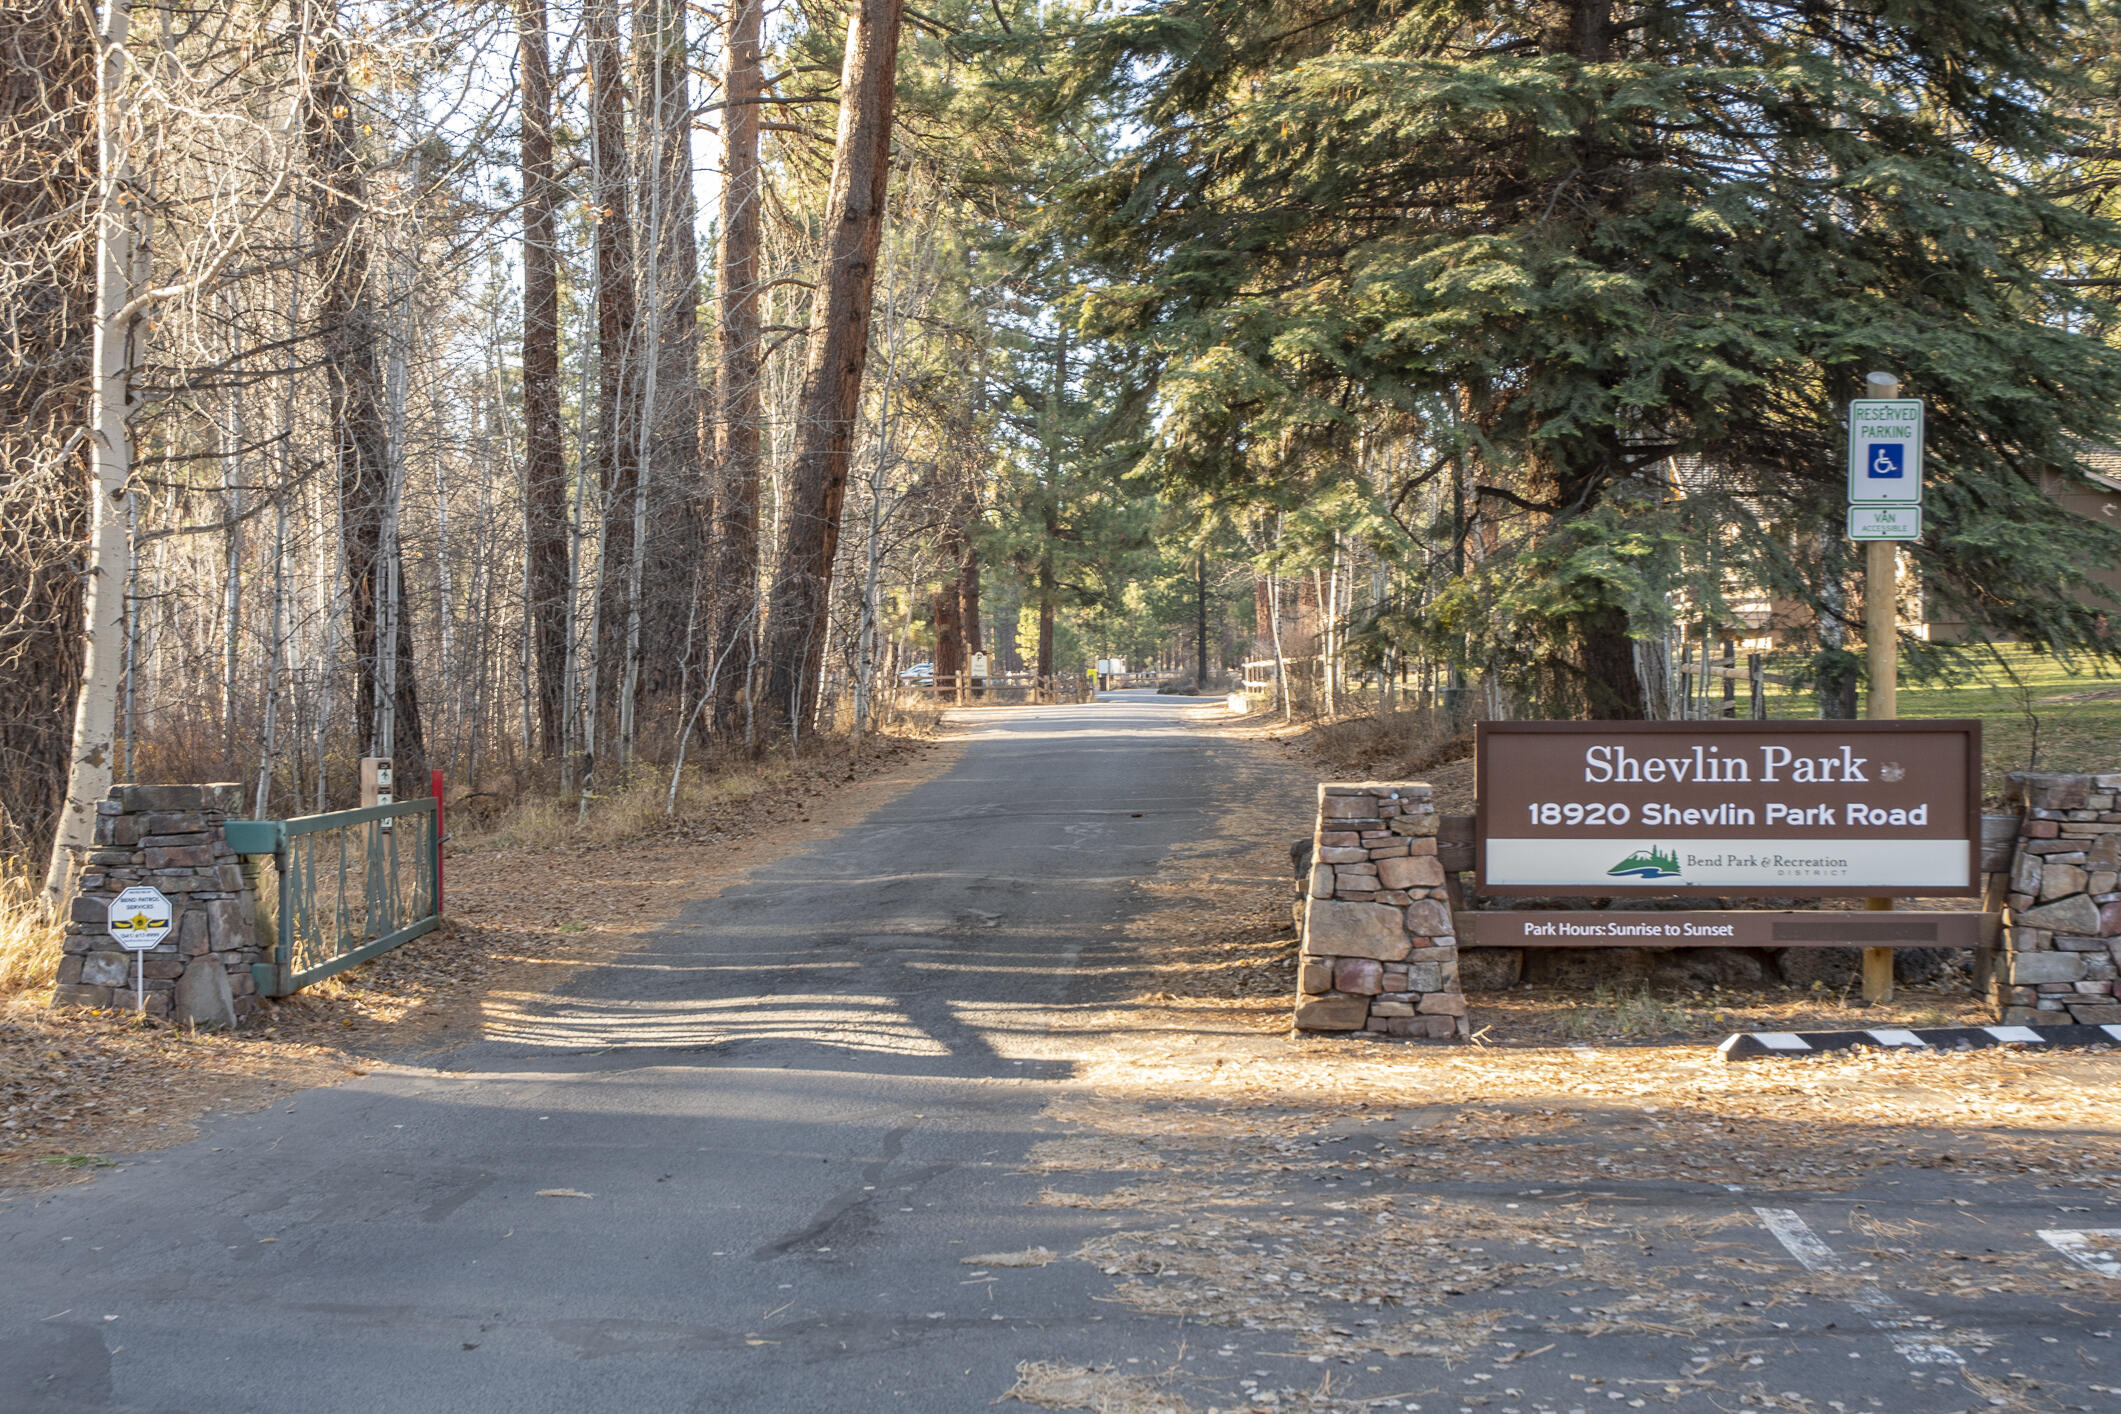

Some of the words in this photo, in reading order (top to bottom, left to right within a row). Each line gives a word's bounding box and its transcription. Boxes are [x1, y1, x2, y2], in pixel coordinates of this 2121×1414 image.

[1856, 408, 1917, 421] RESERVED
[1861, 425, 1912, 438] PARKING
[1874, 513, 1896, 523] VAN
[1585, 745, 1749, 783] Shevlin
[1760, 745, 1869, 783] Park
[1528, 803, 1631, 826] 18920
[1641, 803, 1756, 826] Shevlin
[1765, 803, 1836, 826] Park
[1846, 803, 1928, 826] Road
[1687, 855, 1722, 867] Bend
[1728, 855, 1758, 867] Park
[1773, 855, 1848, 867] Recreation
[1524, 923, 1556, 936] Park
[1559, 923, 1606, 936] Hours:
[1608, 923, 1659, 936] Sunrise
[1664, 924, 1680, 936] to
[1684, 923, 1734, 936] Sunset
